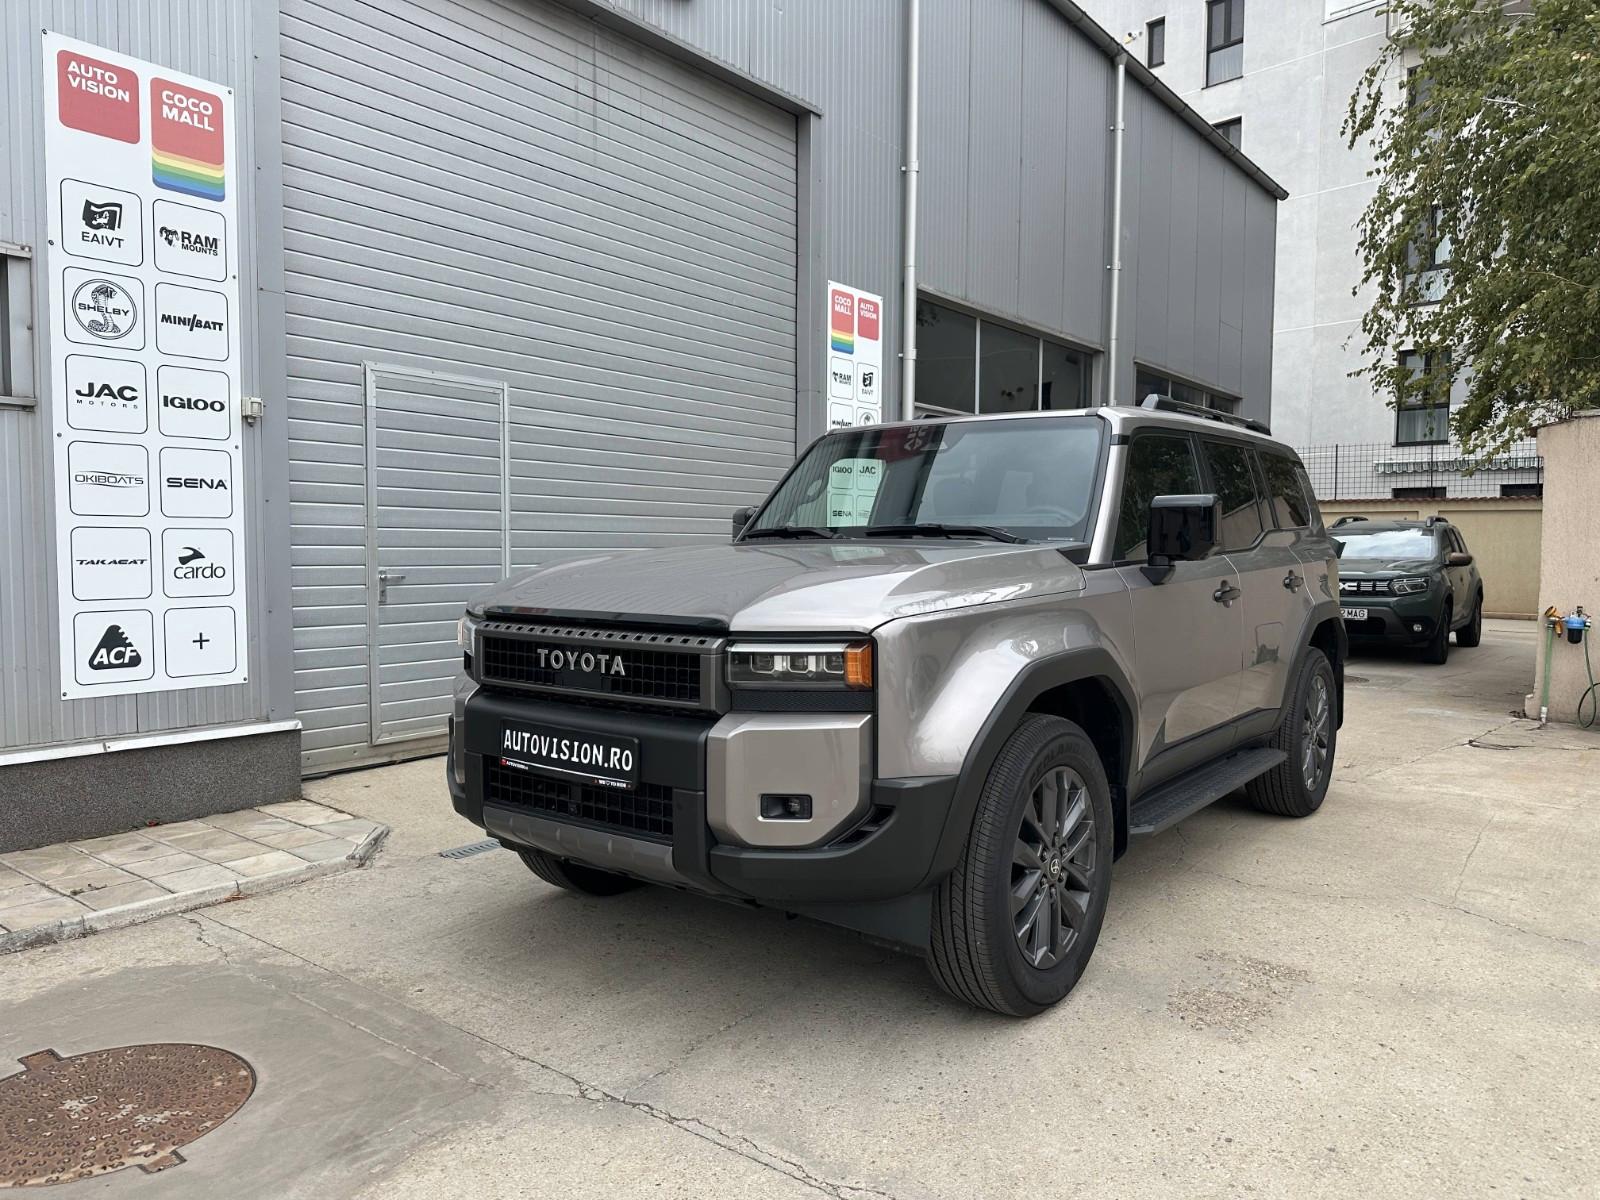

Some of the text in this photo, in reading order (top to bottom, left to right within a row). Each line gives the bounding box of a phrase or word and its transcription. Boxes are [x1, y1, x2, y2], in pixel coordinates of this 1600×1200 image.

[67, 60, 118, 85] AUTO
[67, 74, 130, 104] VISION
[161, 90, 213, 116] COCO
[161, 103, 214, 133] MALL
[81, 231, 125, 249] EAIVT
[181, 231, 218, 250] RAM
[181, 243, 218, 257] MOUNTS
[78, 302, 129, 316] SHELBY
[834, 295, 852, 306] COCO
[860, 302, 874, 311] AUTO
[834, 304, 852, 316] MALL
[860, 309, 877, 320] VISION
[75, 382, 139, 402] JAC
[76, 399, 138, 409] MOTORS
[163, 395, 226, 413] IGLOO
[859, 466, 876, 474] JAC
[75, 474, 144, 486] OKIBOATS
[166, 477, 227, 490] SENA
[173, 562, 226, 580] cardo
[93, 646, 138, 665] ACF
[537, 648, 625, 676] TOYOTA
[503, 729, 632, 771] AUTOVISION.RO
